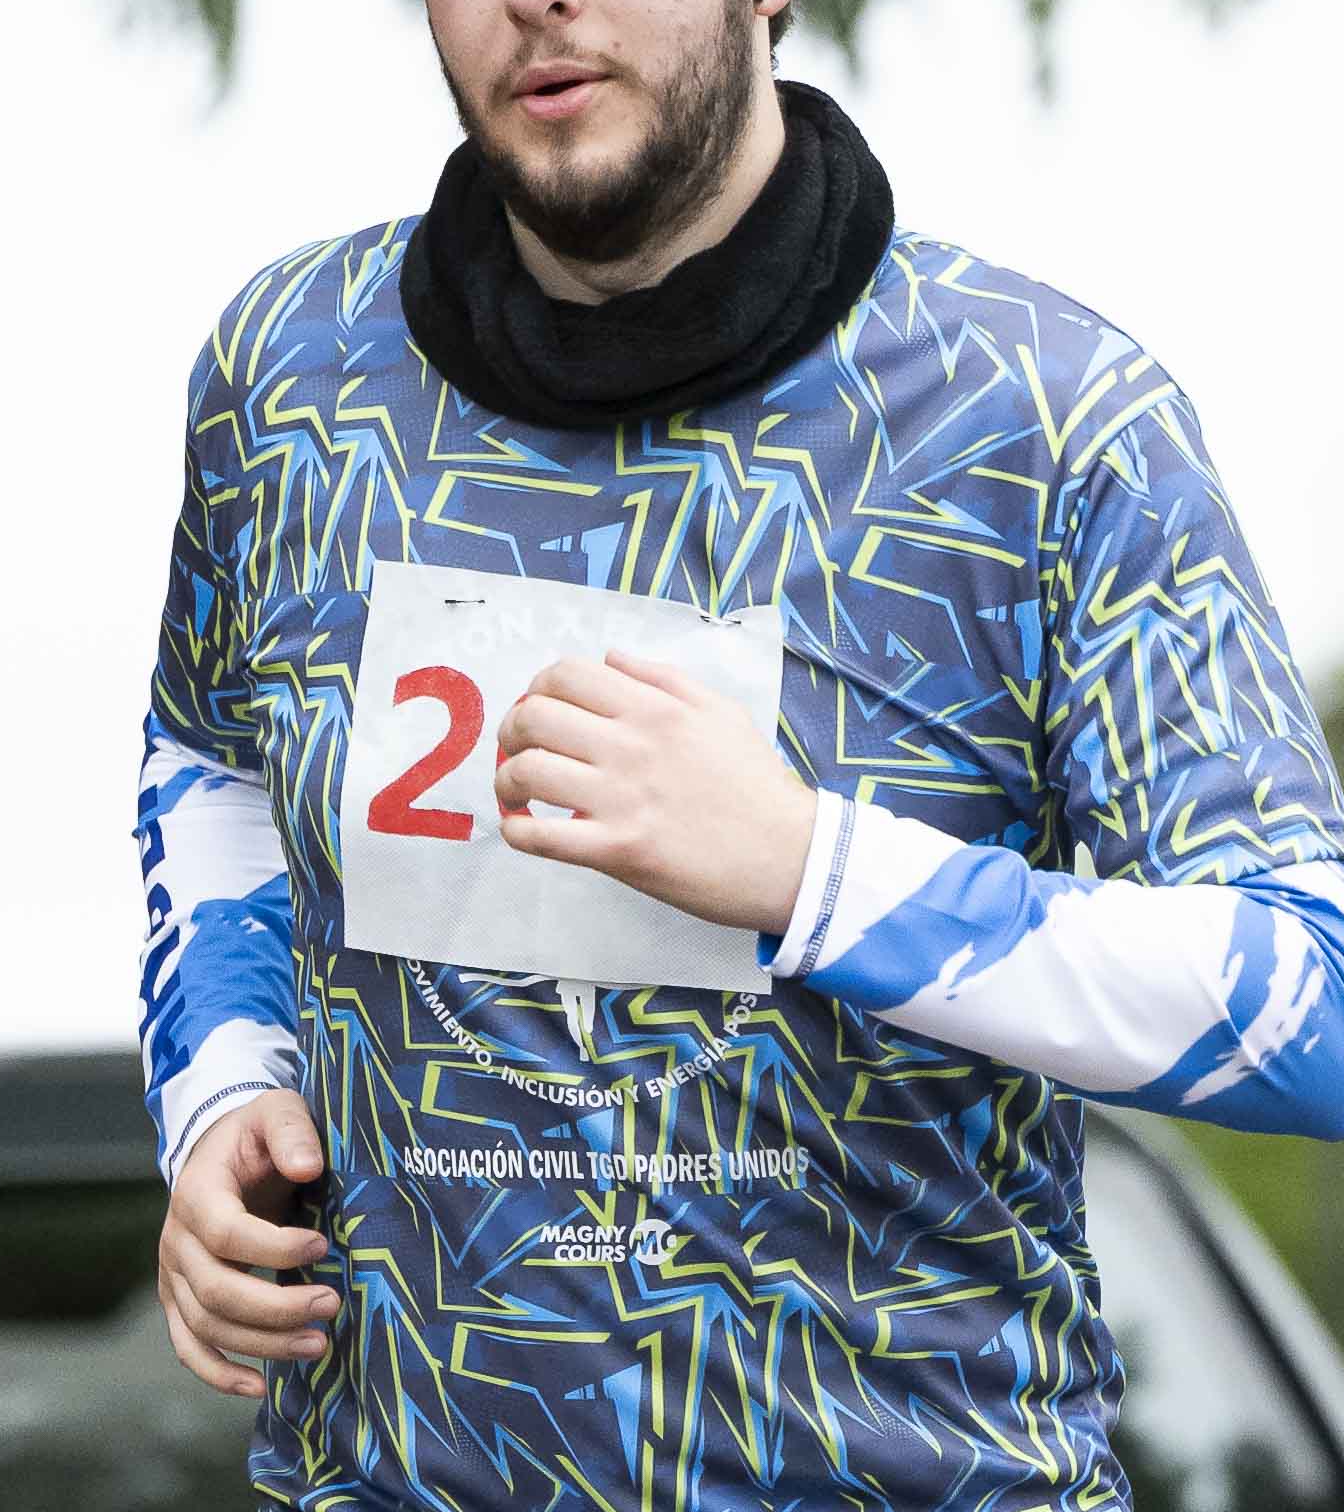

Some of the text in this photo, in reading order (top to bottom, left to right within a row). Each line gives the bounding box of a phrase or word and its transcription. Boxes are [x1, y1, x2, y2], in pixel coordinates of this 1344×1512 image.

[406, 959, 758, 1108] OVIMIENTO, INCLUSIÓN Y ENERGÍA POS
[404, 1140, 810, 1183] ASOCIACIÓN CIVIL TGD PADRES UNIDOS
[539, 1225, 627, 1243] MAGNY
[554, 1244, 627, 1262] COURS
